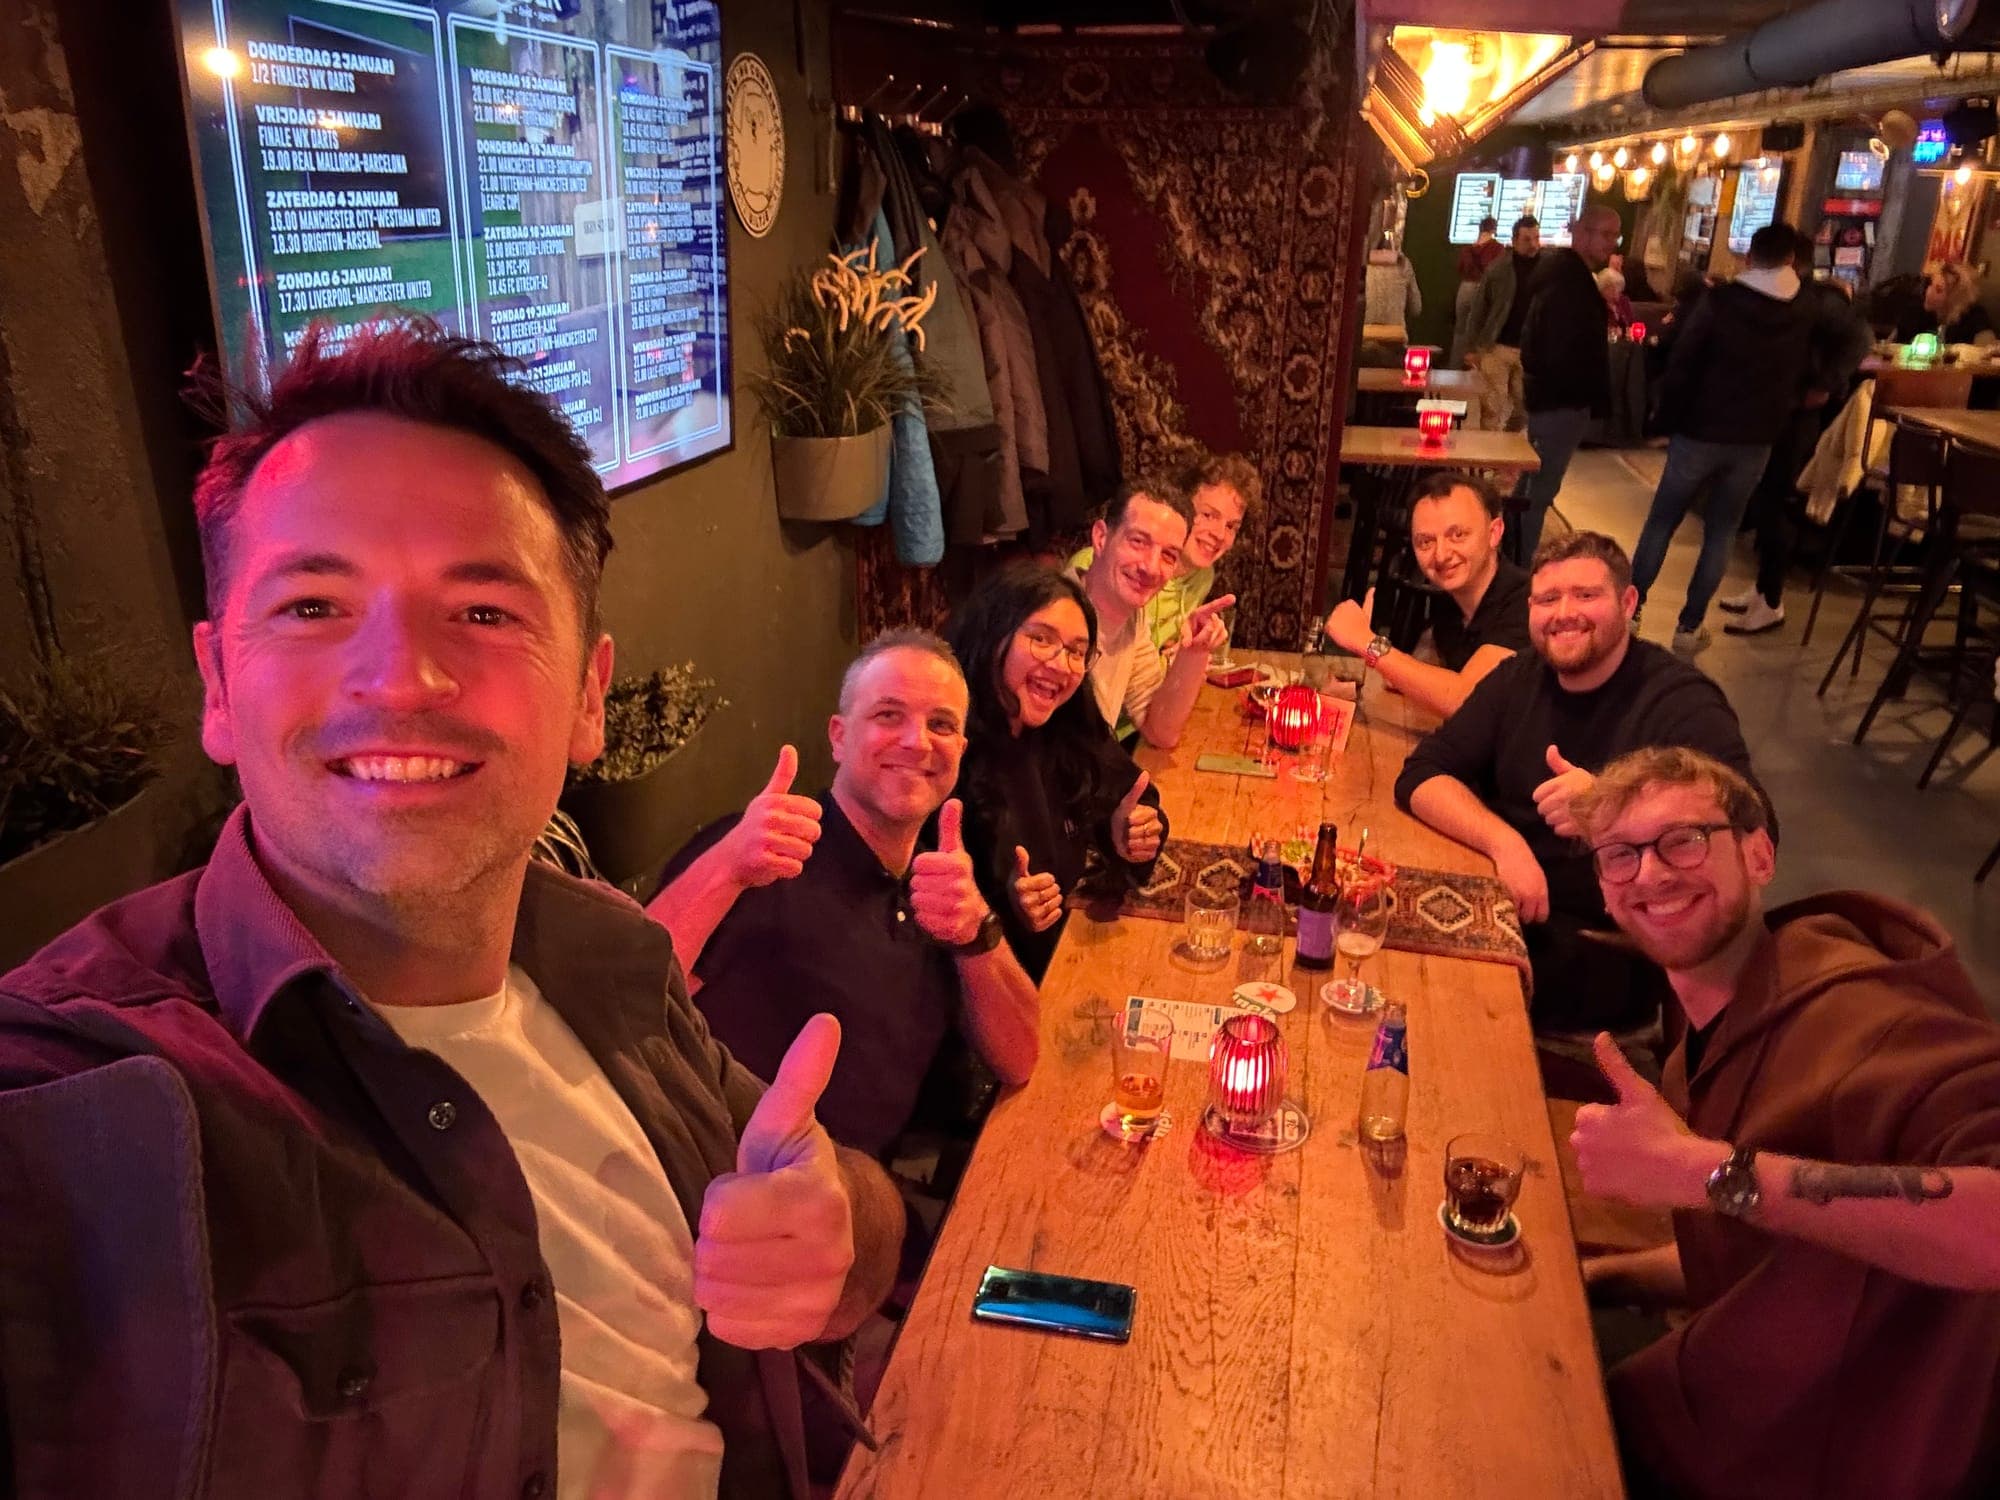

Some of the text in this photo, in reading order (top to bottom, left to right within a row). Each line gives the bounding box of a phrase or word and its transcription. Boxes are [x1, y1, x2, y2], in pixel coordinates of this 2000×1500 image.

[248, 41, 395, 75] DONDERDAG 2 JANUARI
[252, 62, 355, 93] 1/2 FINALES WK DARTS
[470, 68, 520, 88] WOENSDAG
[531, 75, 567, 94] JANUARI
[255, 105, 381, 130] VRIJDAG 3 JANUARI
[258, 126, 339, 150] FINALE WK DARTS
[477, 139, 529, 155] DONDERDAG
[540, 143, 576, 157] JANUARI
[261, 150, 408, 173] 19.00 REAL MALLORCA-BARCELONA
[498, 156, 535, 173] MANCHESTER
[266, 191, 399, 208] ZATERDAG 4 JANUARI
[269, 208, 441, 231] 16.00 MANCHESTER CITY-WESTHAM UNITED
[271, 230, 382, 254] 18.30 BRIGHTON-ARSENAL
[484, 226, 528, 240] ZATERDAG
[541, 225, 573, 237] JANUARI
[276, 266, 392, 291] ZONDAG 6 JANUARI
[279, 280, 432, 313] 17.30 LIVERPOOL-MANCHESTER UNITED
[490, 308, 525, 325] ZONDAG
[536, 302, 570, 318] JANUARI
[543, 360, 576, 376] JANUARI
[635, 387, 670, 406] DONDERDAG
